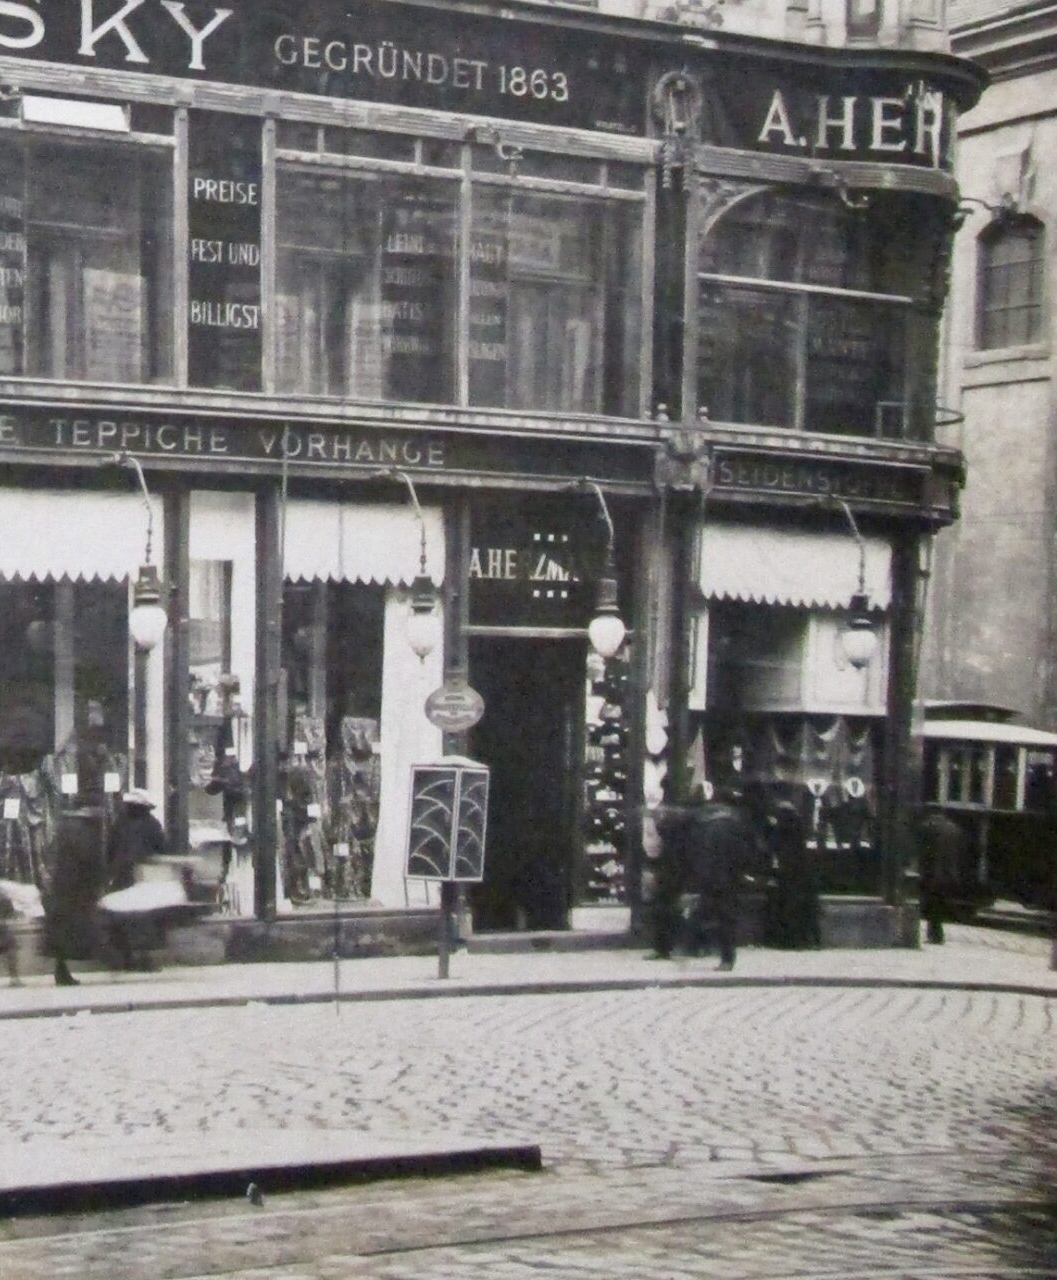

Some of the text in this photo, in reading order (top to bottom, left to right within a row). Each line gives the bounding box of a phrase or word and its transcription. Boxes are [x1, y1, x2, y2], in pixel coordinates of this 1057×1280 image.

[273, 33, 570, 103] GEGRÜNDET 1863
[193, 177, 258, 206] PREISE
[191, 238, 260, 267] FEST UND
[191, 299, 259, 330] BILLIGST
[49, 419, 229, 453] TEPPICHE
